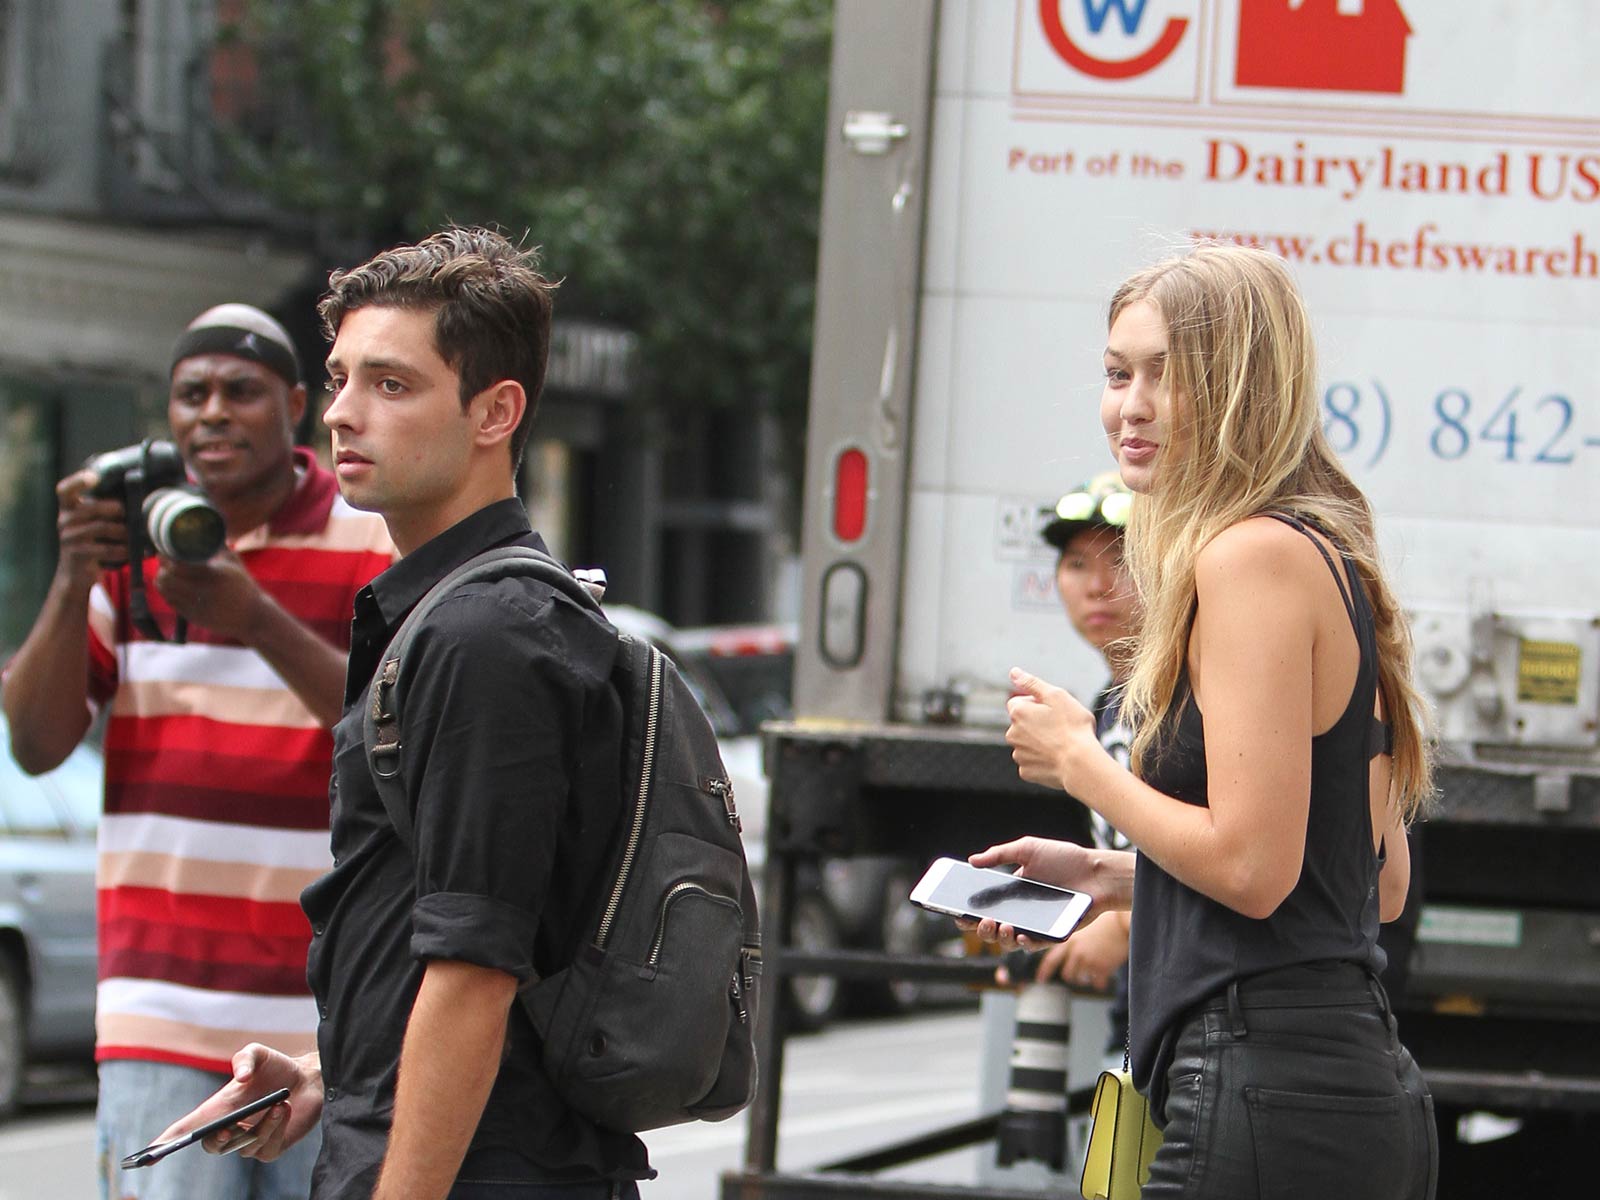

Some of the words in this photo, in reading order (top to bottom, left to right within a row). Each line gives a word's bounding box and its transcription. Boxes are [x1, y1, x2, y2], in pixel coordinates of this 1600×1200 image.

[1009, 148, 1074, 174] Part
[1086, 150, 1119, 177] of
[1131, 153, 1185, 180] the
[1205, 139, 1510, 200] Dairyland
[1527, 153, 1600, 203] US
